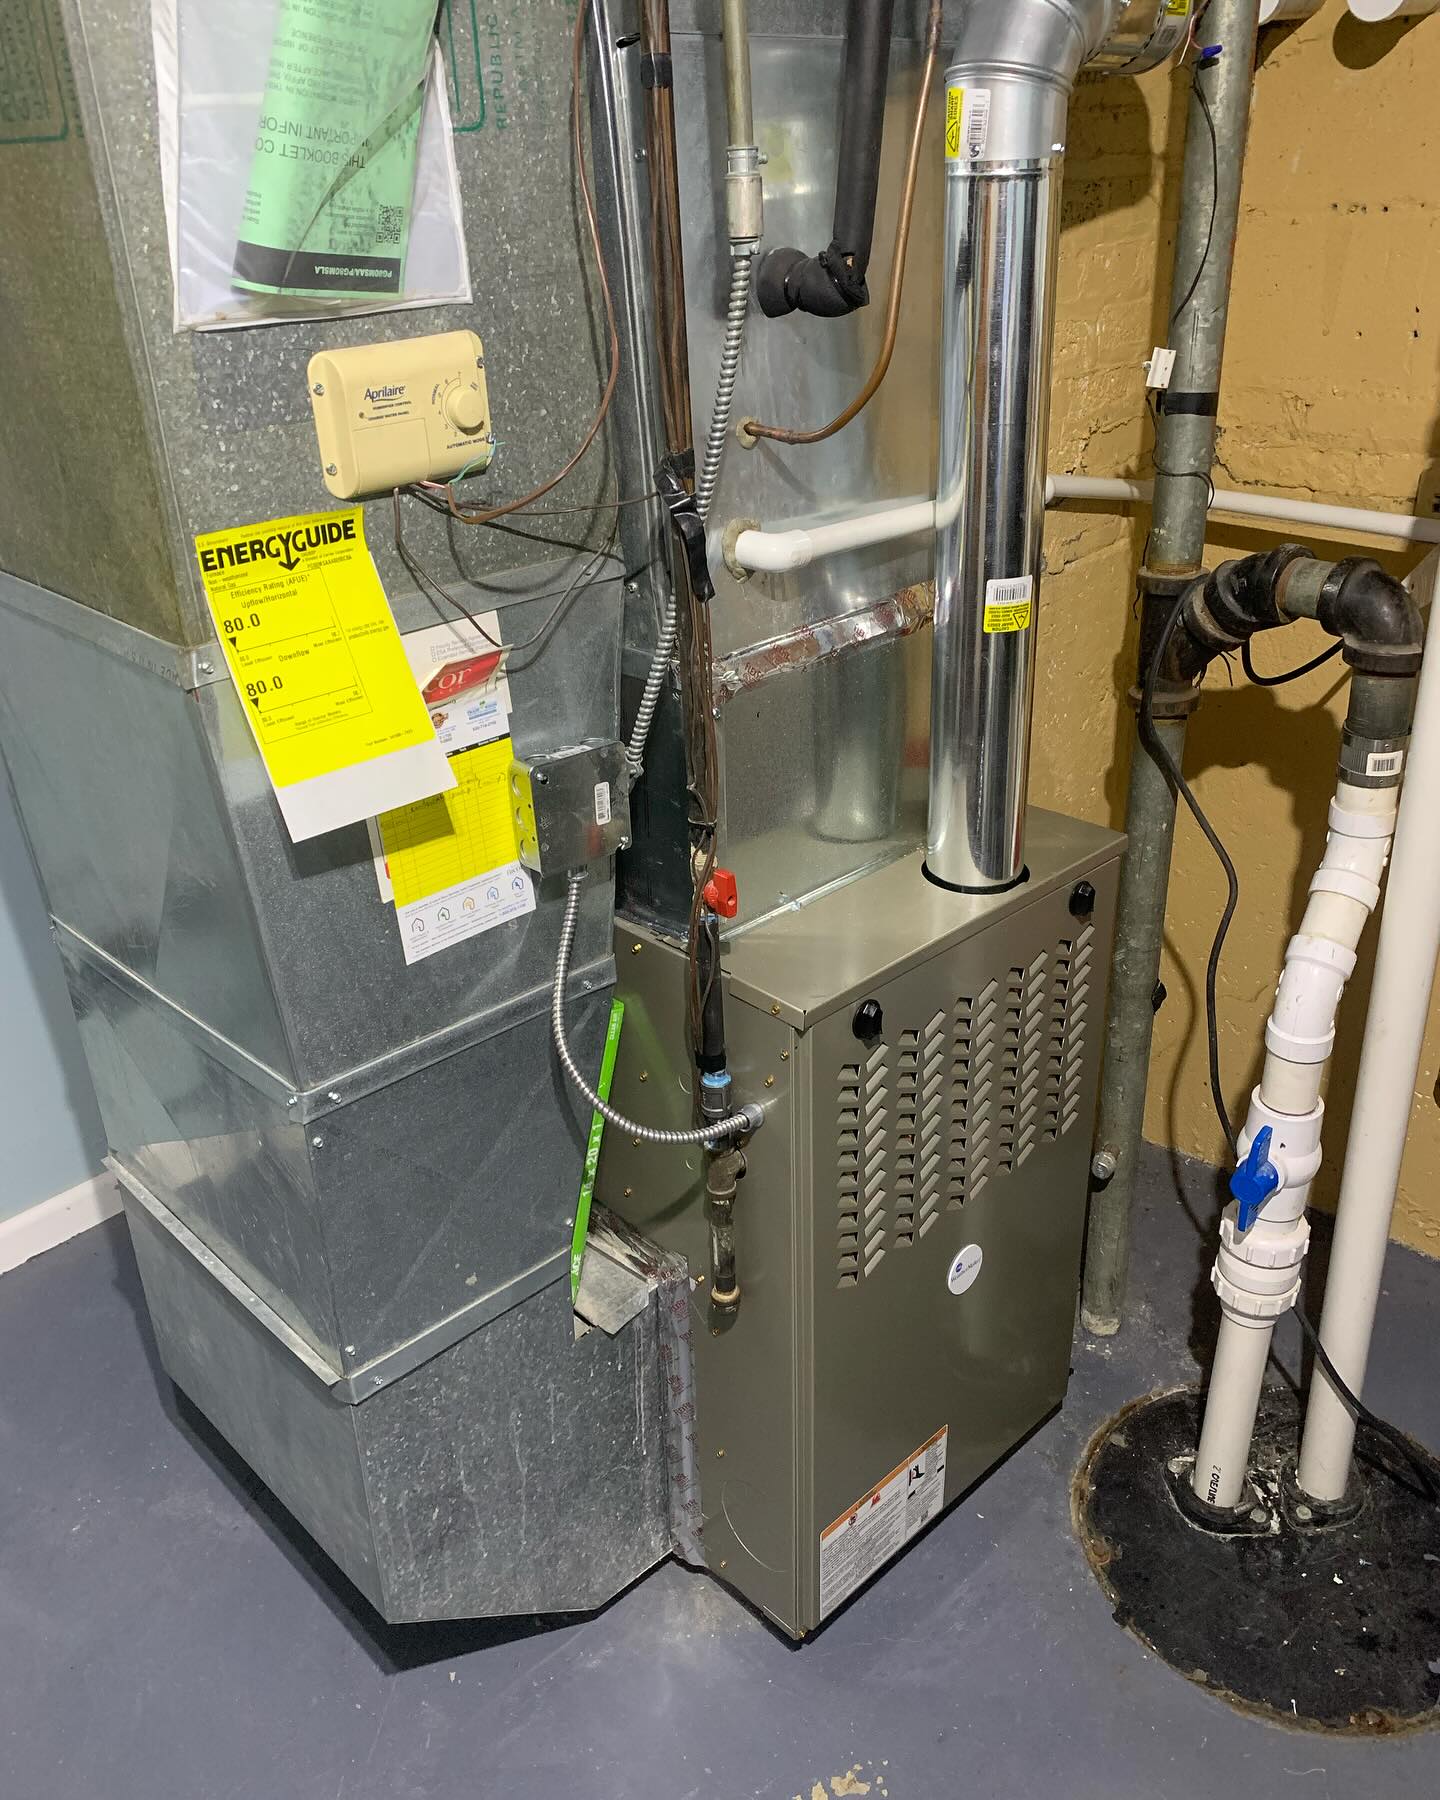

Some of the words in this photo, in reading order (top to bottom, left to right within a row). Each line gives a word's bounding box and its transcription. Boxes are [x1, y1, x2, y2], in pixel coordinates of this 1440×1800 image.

[279, 143, 339, 166] BOOKLET
[364, 385, 405, 402] Aprilaire
[200, 518, 357, 572] ENERGYGUIDE
[230, 586, 262, 599] Efficiency
[263, 578, 285, 591] Rating
[241, 588, 298, 610] Upflow/Horizontal
[223, 613, 261, 634] 80.0
[278, 649, 310, 662] Downflow
[246, 675, 283, 697] 80.0
[587, 1148, 599, 1166] 20
